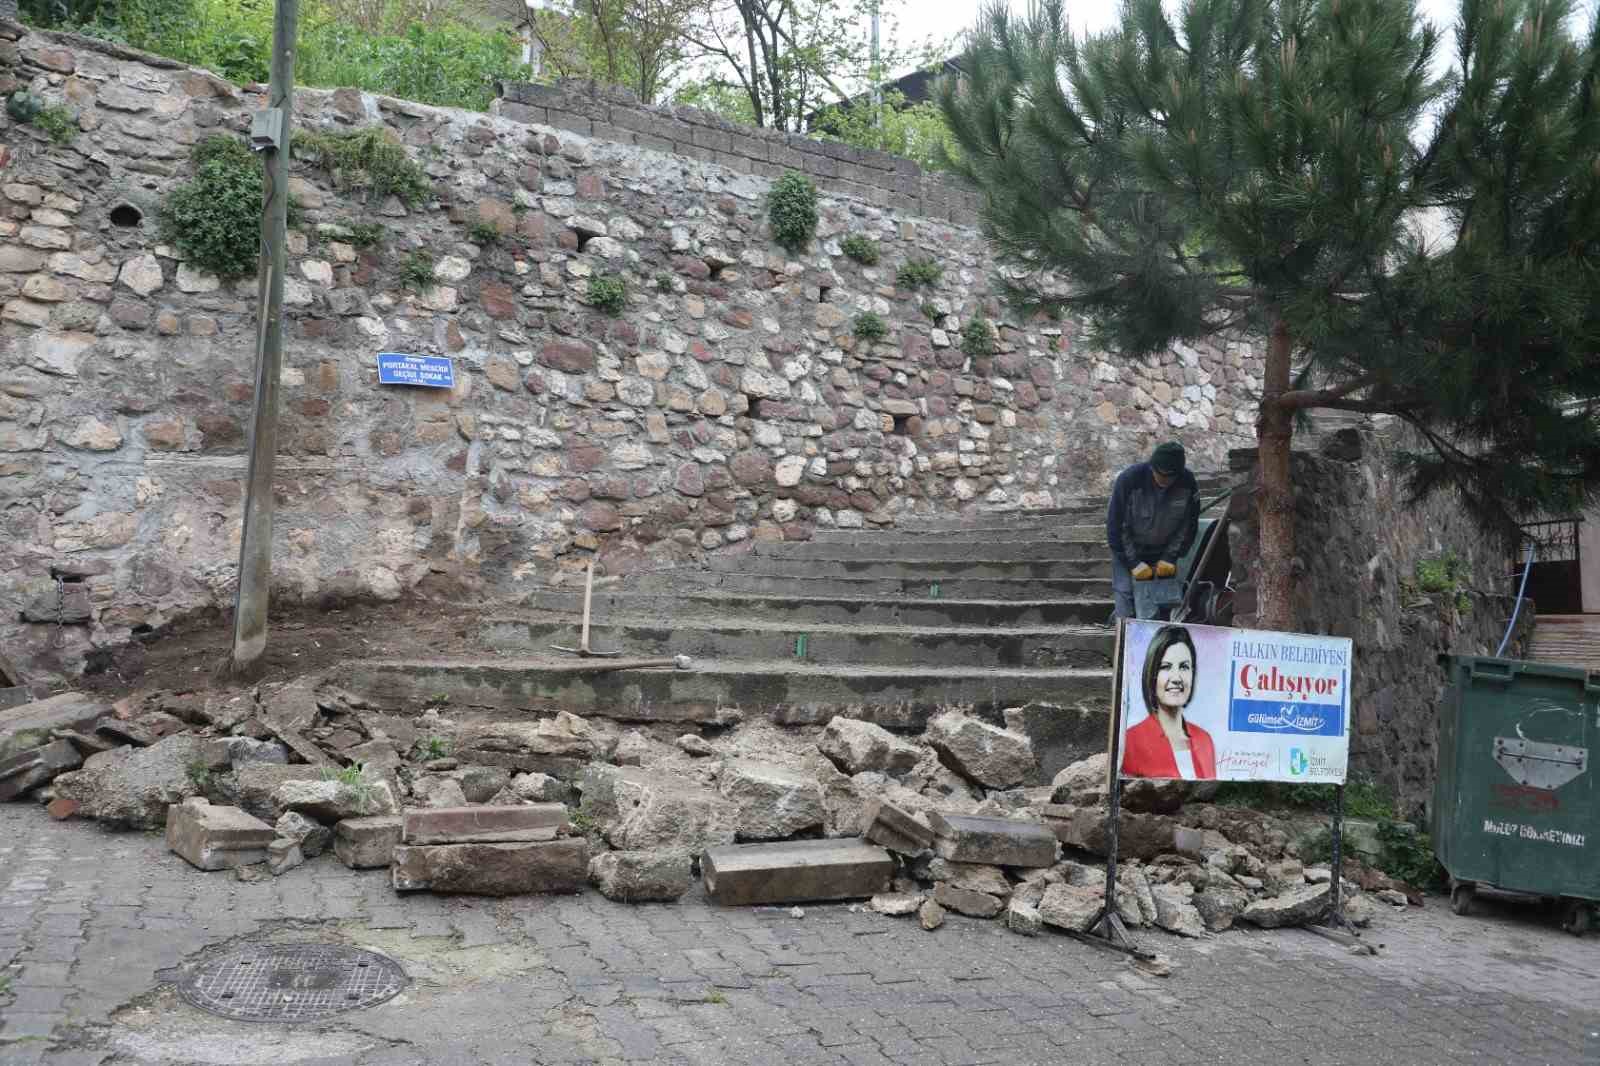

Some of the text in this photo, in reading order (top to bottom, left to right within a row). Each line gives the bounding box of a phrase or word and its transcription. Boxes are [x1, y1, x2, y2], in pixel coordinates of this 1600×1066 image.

[383, 361, 417, 369] PORTAKAL
[420, 372, 442, 381] SOKAK
[1232, 640, 1347, 667] HALKIN BELEDİYESİ
[1240, 663, 1338, 701] Çalışıyor
